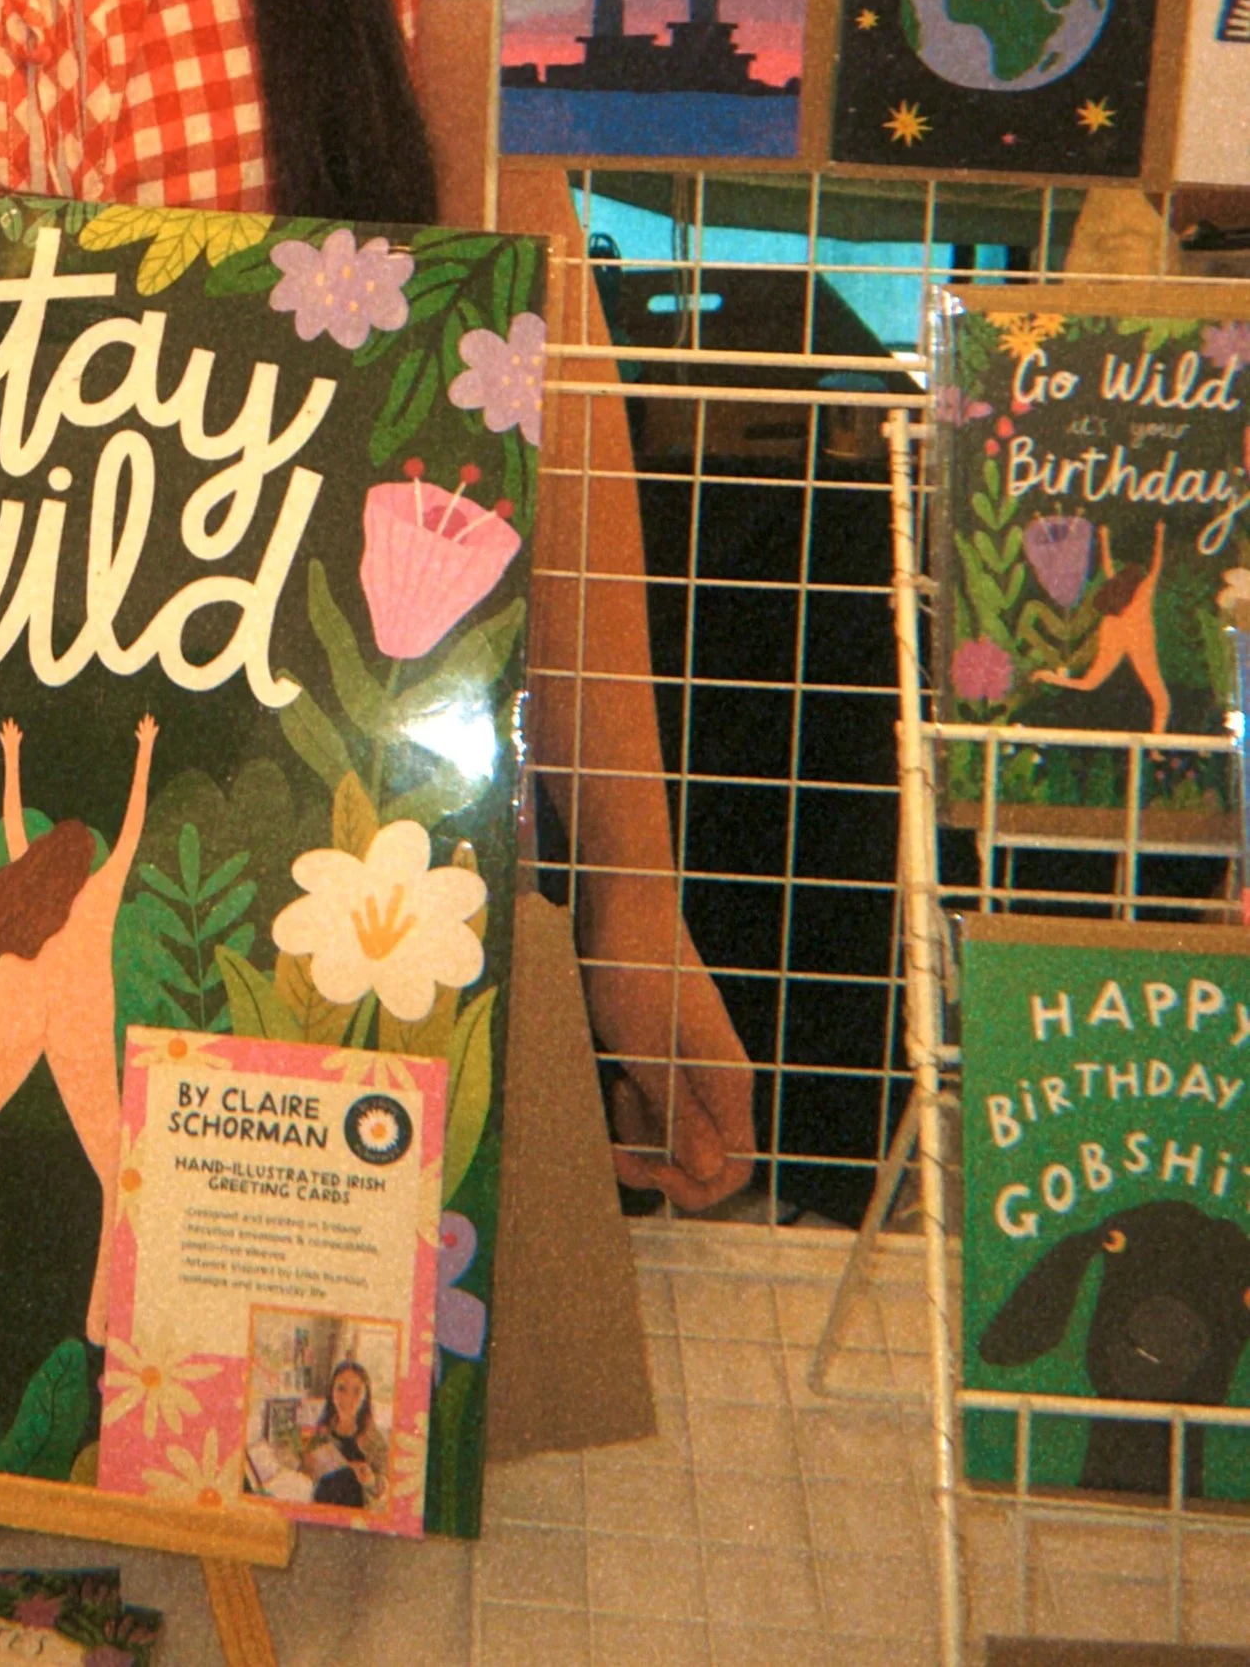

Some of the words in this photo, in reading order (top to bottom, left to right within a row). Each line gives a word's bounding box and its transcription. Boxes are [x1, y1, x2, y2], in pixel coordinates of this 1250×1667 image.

[1013, 348, 1079, 404] Go
[1101, 350, 1241, 410] Wild
[1007, 436, 1250, 555] Birthday
[178, 1082, 209, 1108] BY
[221, 1087, 321, 1120] CLAIRE
[167, 1110, 329, 1149] SCHORMAN
[175, 1155, 341, 1187] HAND-ILLUSTRATED
[346, 1173, 387, 1193] IRISH
[208, 1175, 291, 1200] GREETING
[297, 1184, 352, 1205] CARDS
